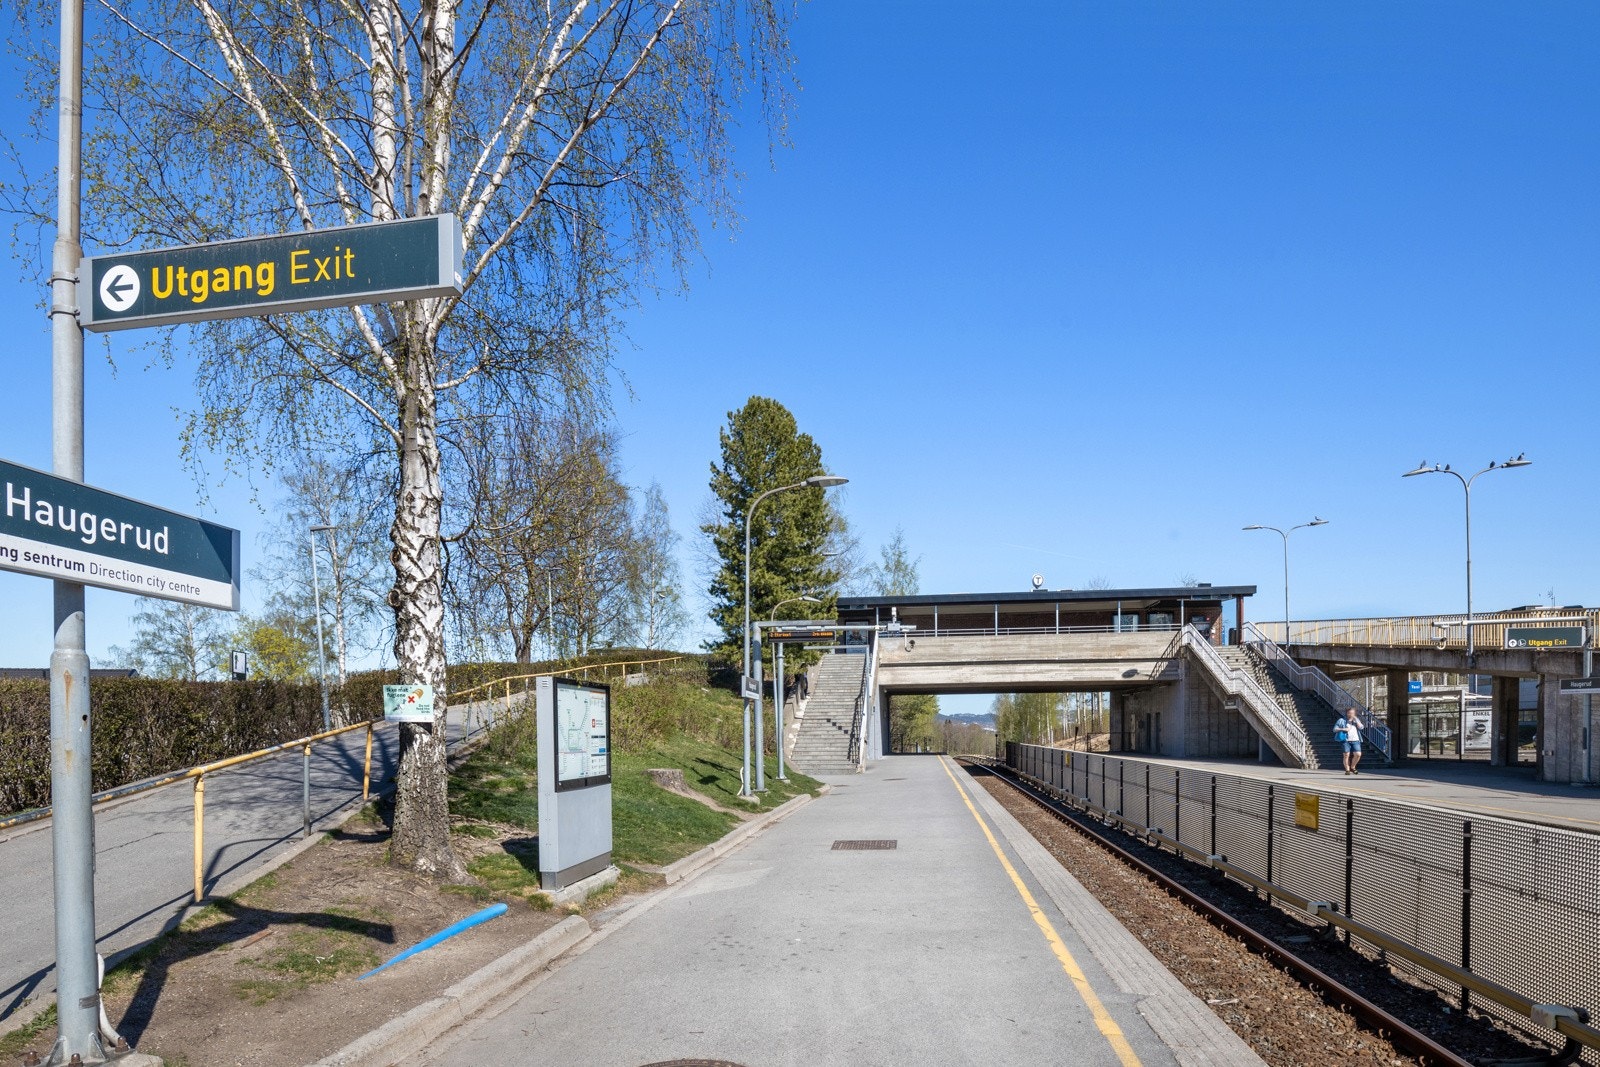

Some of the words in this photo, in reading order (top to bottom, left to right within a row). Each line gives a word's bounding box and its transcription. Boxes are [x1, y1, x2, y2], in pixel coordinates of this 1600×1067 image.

[152, 261, 275, 303] Utgang
[290, 246, 355, 285] Exit
[6, 482, 169, 555] Haugerud
[24, 551, 85, 573] sentrum
[90, 562, 143, 585] Direction
[147, 577, 166, 591] city
[169, 582, 201, 596] centre
